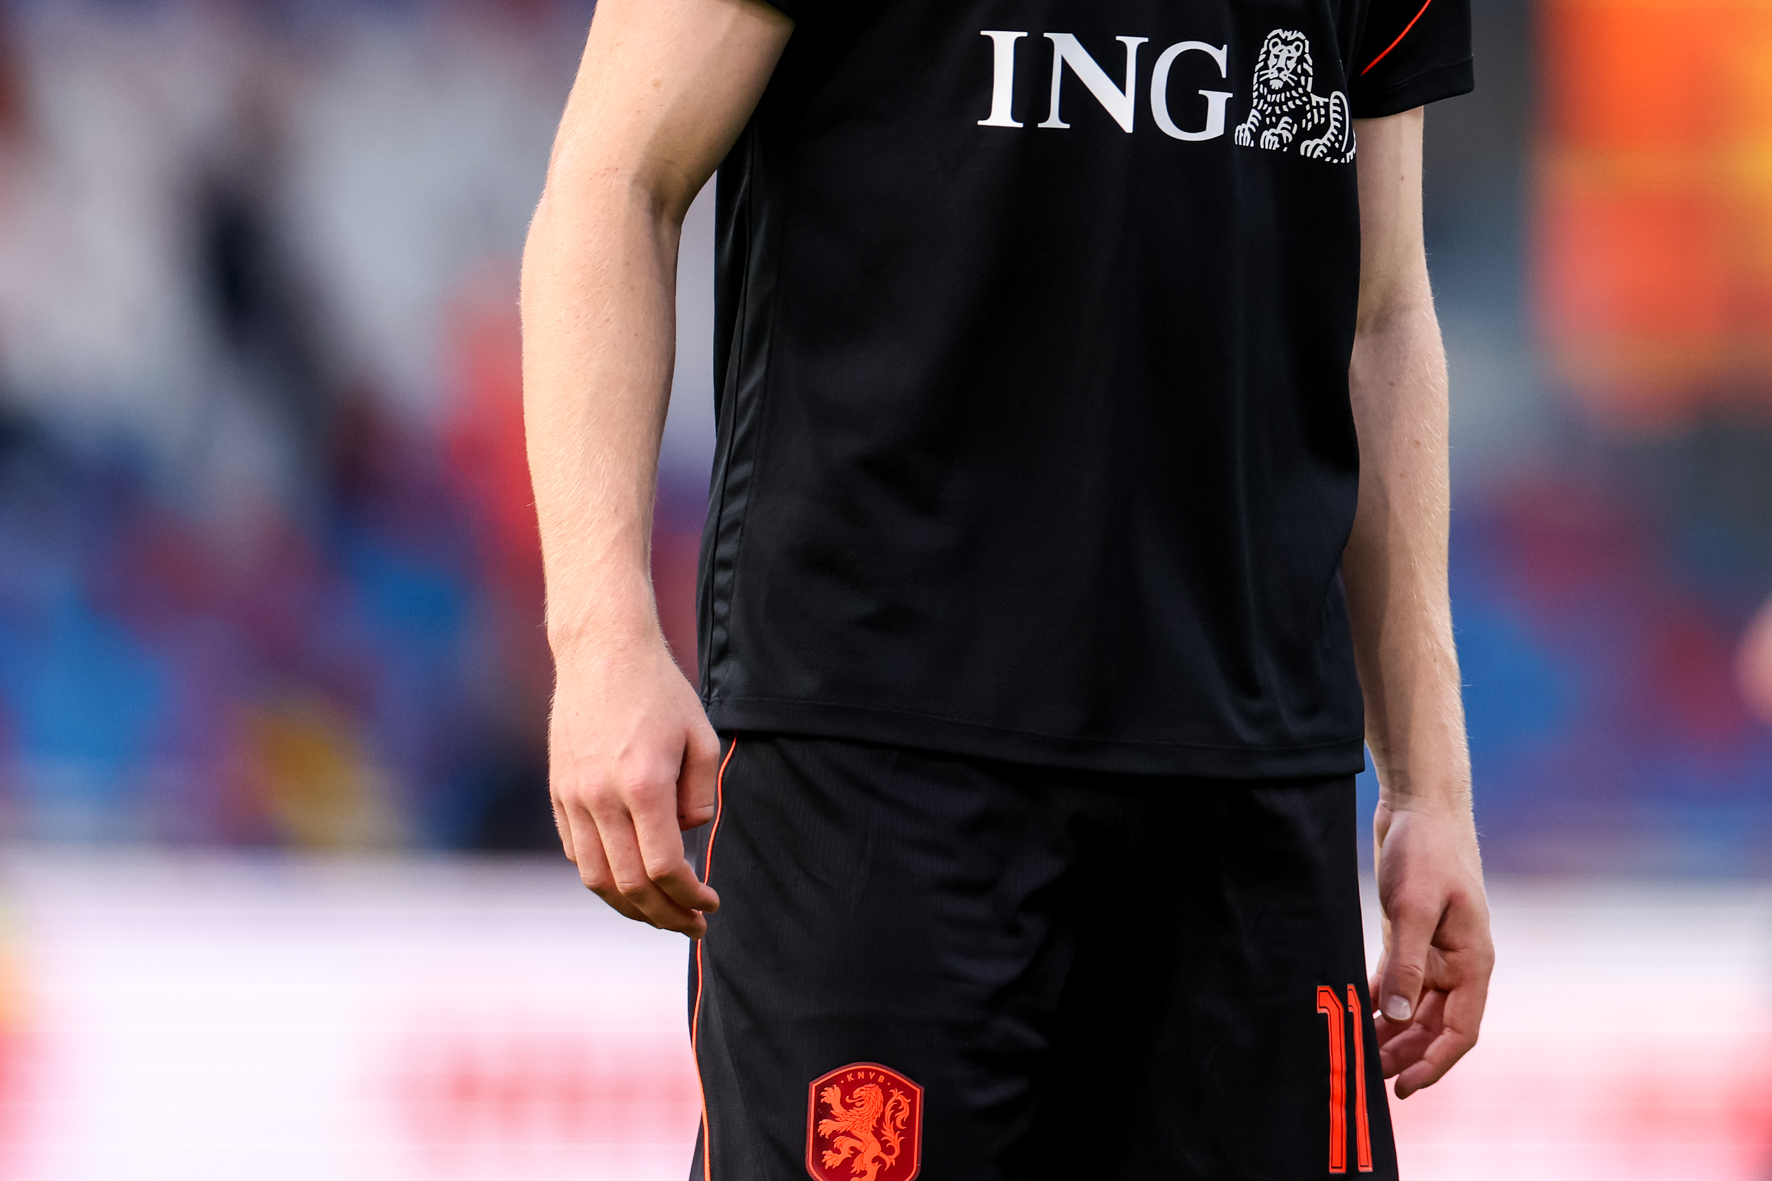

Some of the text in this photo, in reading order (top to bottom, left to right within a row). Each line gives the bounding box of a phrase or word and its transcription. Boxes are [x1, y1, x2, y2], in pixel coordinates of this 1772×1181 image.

[977, 30, 1234, 141] ING
[846, 1071, 885, 1083] KNVB
[1316, 983, 1374, 1174] 11
